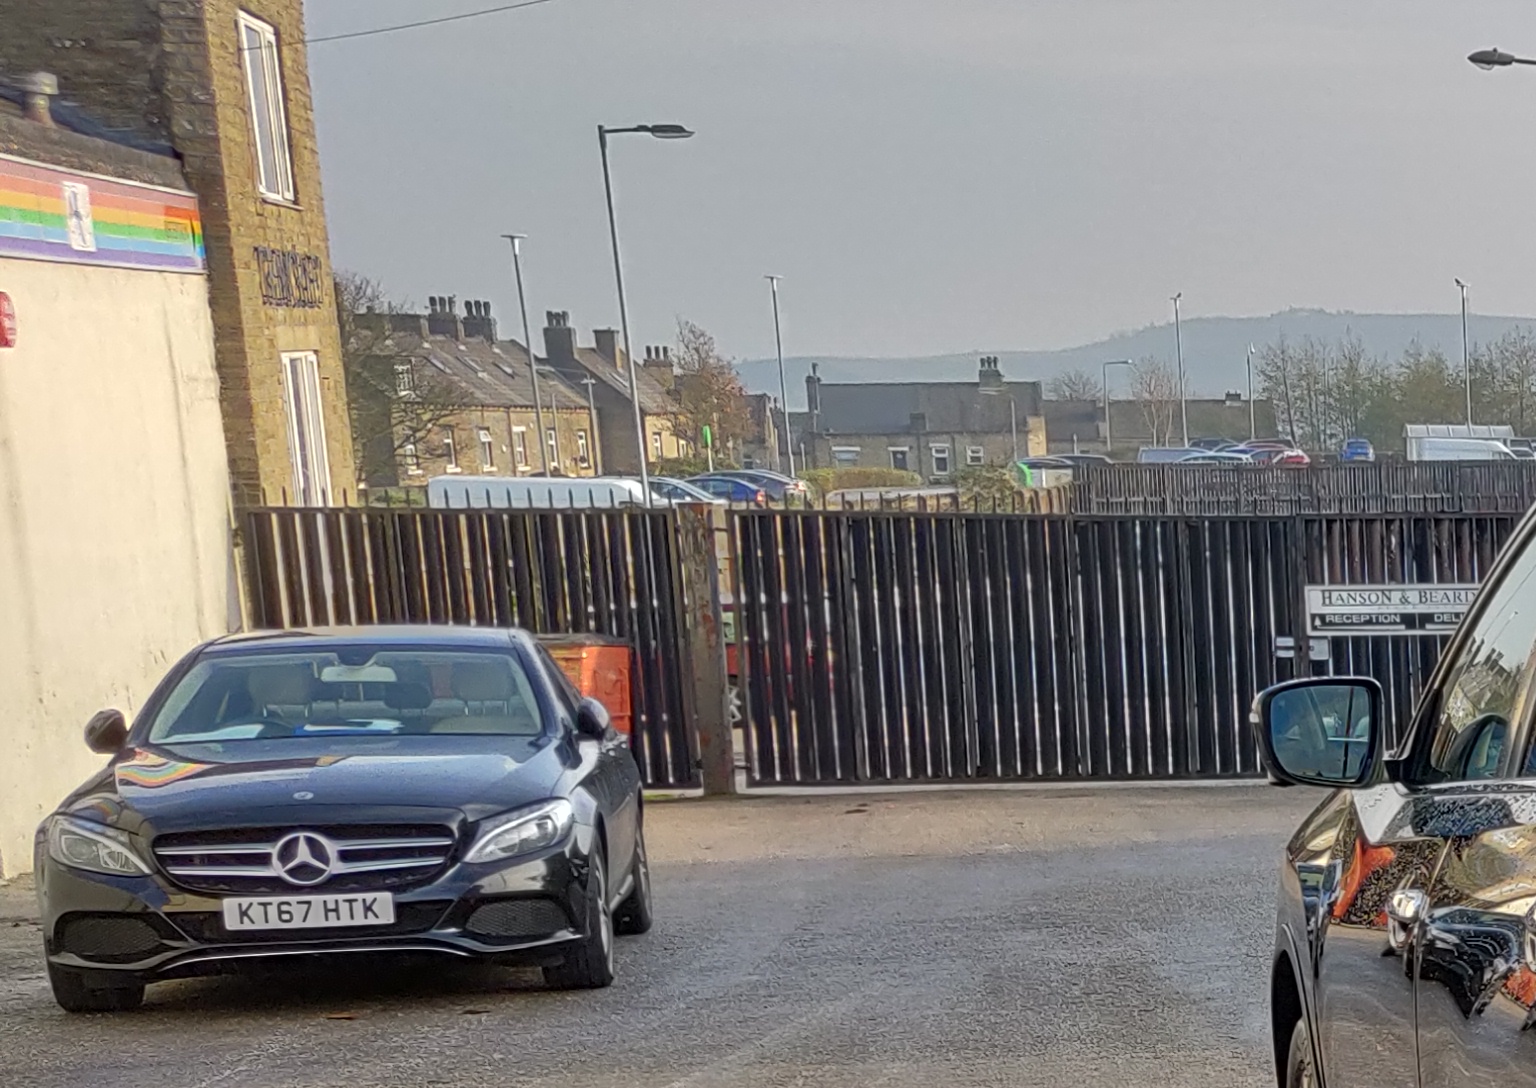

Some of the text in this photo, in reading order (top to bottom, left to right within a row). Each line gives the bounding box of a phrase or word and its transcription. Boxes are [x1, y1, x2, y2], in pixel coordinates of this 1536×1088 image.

[1322, 590, 1392, 605] HANSON
[1399, 591, 1411, 605] &
[1326, 614, 1401, 623] RECEPTION
[238, 897, 380, 925] KT67 HTK
